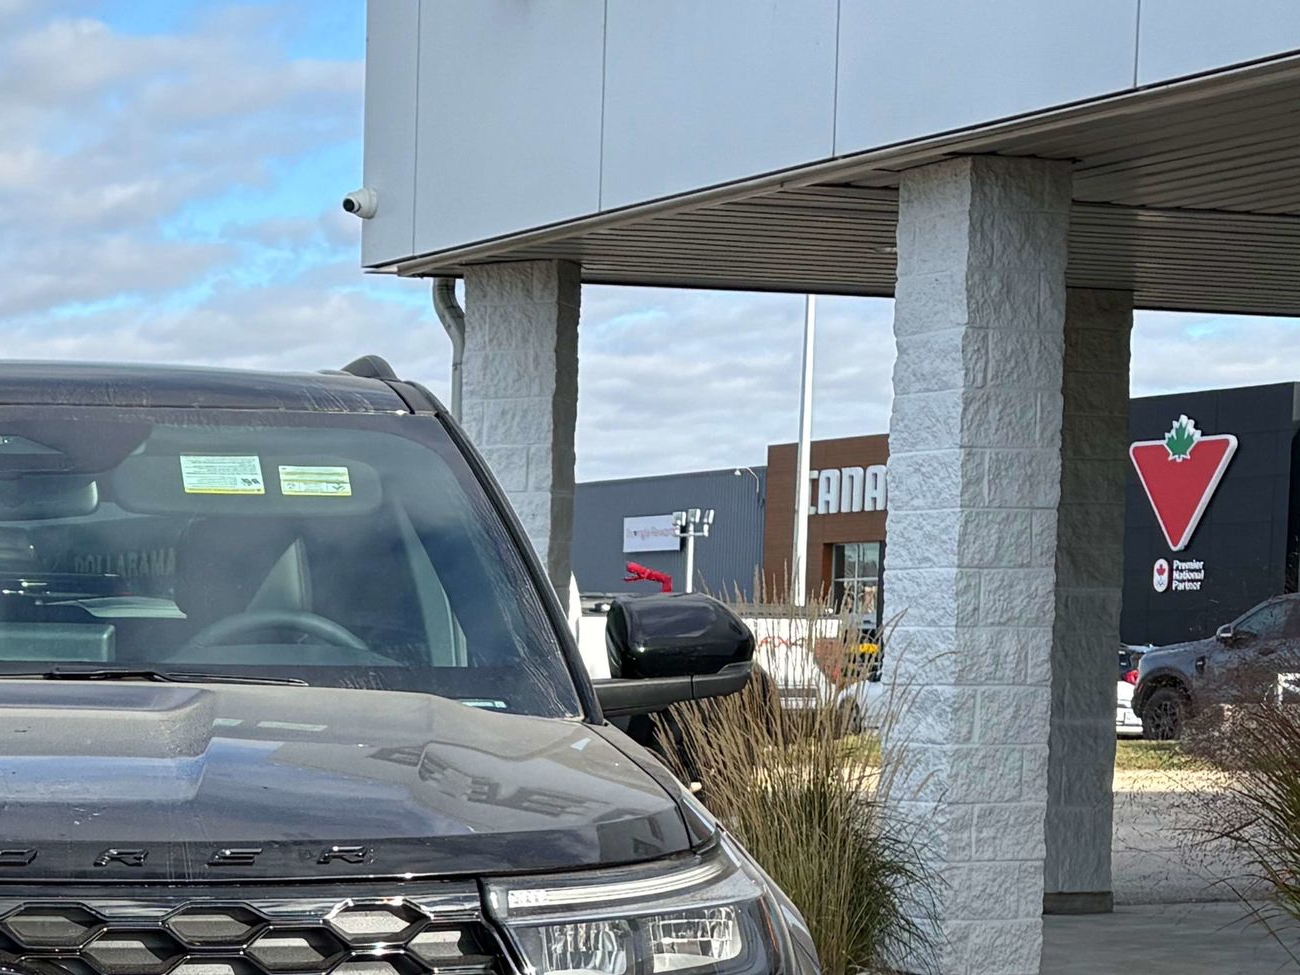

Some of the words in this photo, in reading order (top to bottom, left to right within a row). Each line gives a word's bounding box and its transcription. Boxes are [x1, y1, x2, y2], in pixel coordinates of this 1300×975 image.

[1173, 559, 1204, 570] Premier
[1173, 569, 1205, 580] National
[1172, 580, 1201, 591] Partner
